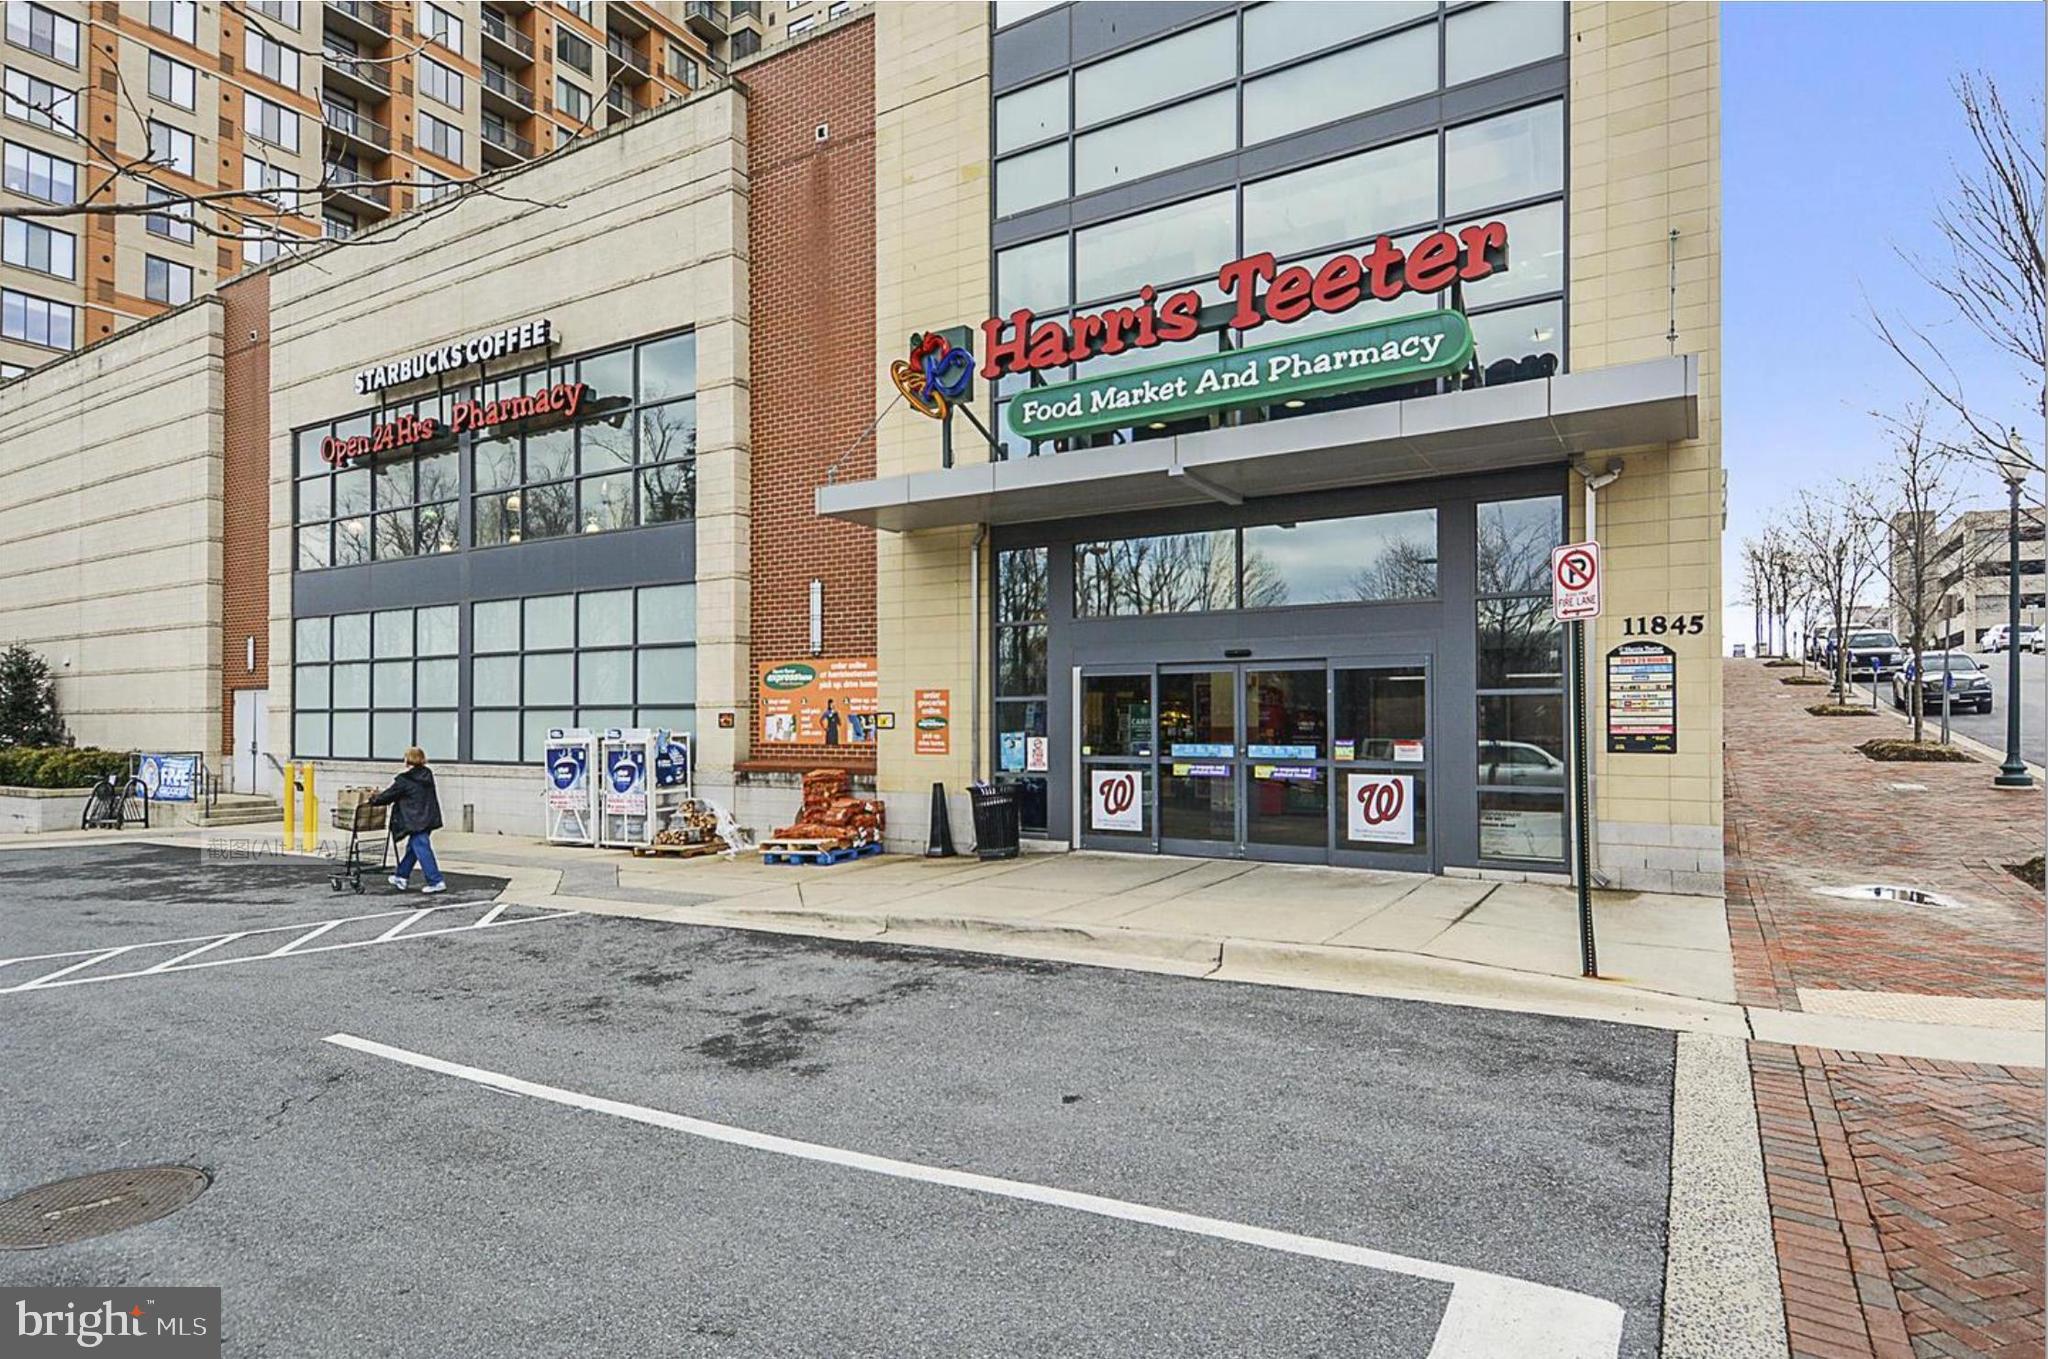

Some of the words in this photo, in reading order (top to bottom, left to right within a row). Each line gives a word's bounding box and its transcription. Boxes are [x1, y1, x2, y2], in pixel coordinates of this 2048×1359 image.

[980, 285, 1202, 381] Harris
[1218, 220, 1509, 332] Teeter
[353, 344, 463, 395] STARBUCKS
[464, 318, 550, 363] COFFEE
[1020, 391, 1084, 426] Food
[1089, 377, 1188, 415] Market
[1196, 362, 1260, 394] And
[1266, 329, 1447, 385] Pharmacy
[320, 434, 370, 468] Open
[371, 425, 394, 453] 24
[395, 413, 435, 447] Hrs
[451, 382, 586, 435] Pharmacy
[1558, 598, 1574, 608] FIRE
[1576, 594, 1596, 606] LANE
[1623, 614, 1705, 636] 11845
[1099, 773, 1135, 815] W
[1357, 778, 1405, 825] W
